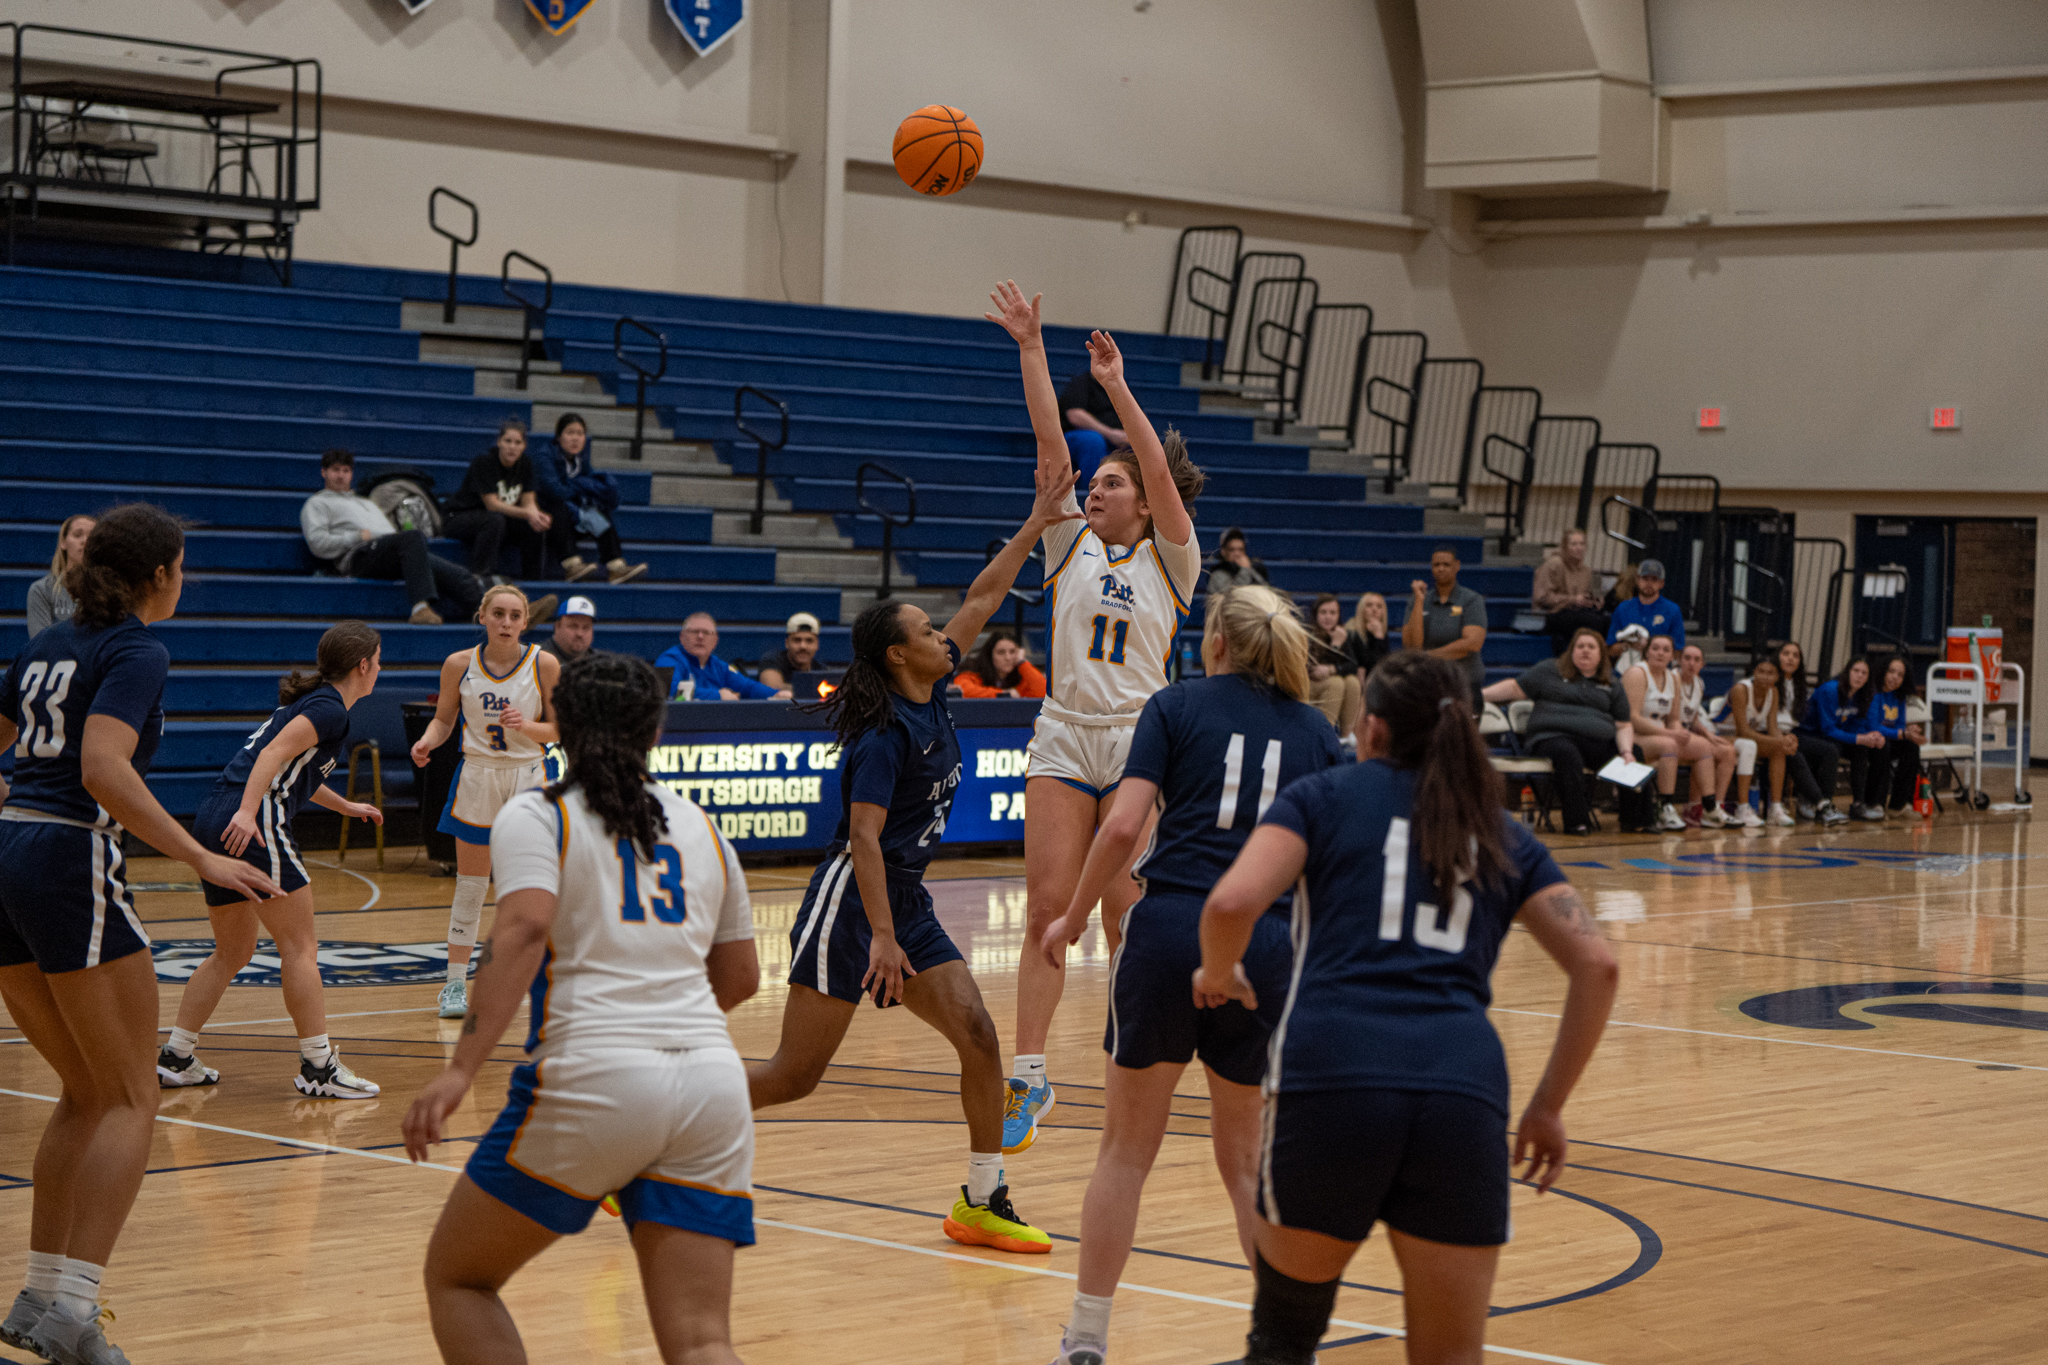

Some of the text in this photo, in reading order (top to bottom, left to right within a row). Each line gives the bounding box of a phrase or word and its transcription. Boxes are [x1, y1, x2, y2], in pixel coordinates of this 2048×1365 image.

[1087, 612, 1130, 666] 11
[486, 724, 507, 752] 3
[649, 743, 804, 773] NIVERSITY
[976, 748, 1031, 778] HOM
[657, 776, 822, 807] TTSBURGH
[1216, 732, 1283, 830] 11
[989, 792, 1026, 821] PA
[708, 811, 808, 840] DFORD
[613, 835, 689, 927] 13
